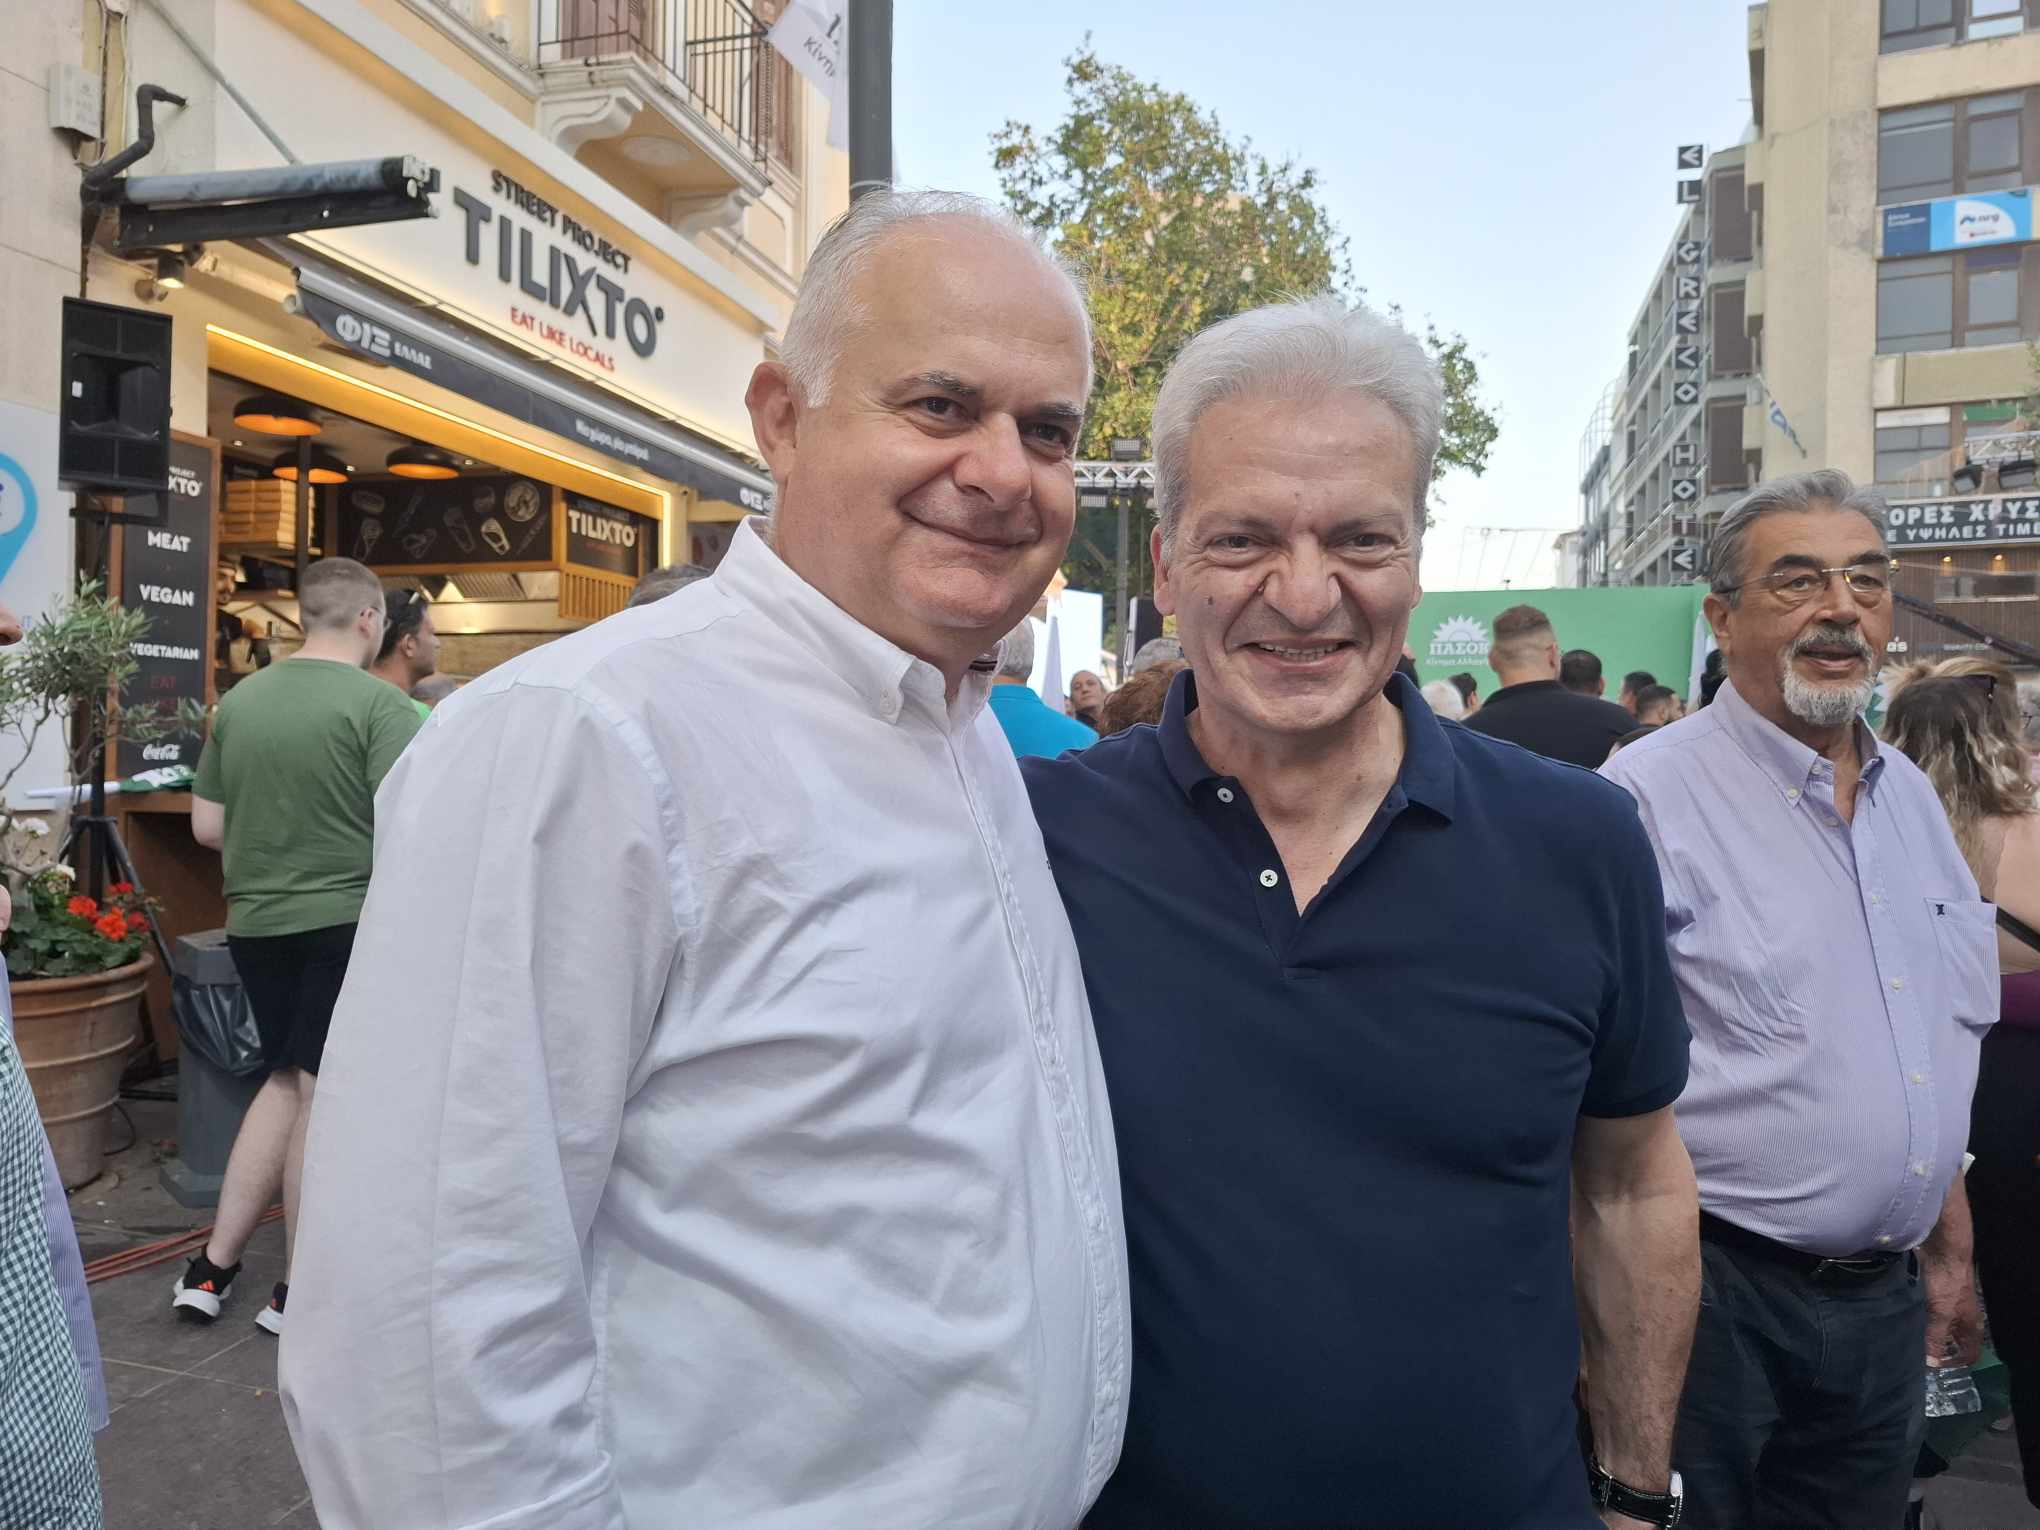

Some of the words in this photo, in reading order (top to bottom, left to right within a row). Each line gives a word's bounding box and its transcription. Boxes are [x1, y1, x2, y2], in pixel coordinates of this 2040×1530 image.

[491, 169, 559, 227] STREET
[562, 213, 631, 274] PROJECT
[453, 186, 657, 358] TILIXTO
[511, 306, 536, 333] EAT
[539, 320, 566, 350] LIKE
[569, 337, 615, 372] LOCALS
[168, 473, 201, 497] XTO
[1672, 444, 1698, 571] HOTE
[1888, 504, 1956, 526] ΟΡΕΣ
[568, 508, 636, 548] TILIXTO
[1886, 529, 1897, 542] Ε
[1906, 525, 1987, 541] ΥΨΗΛΕΣ
[147, 530, 191, 552] MEAT
[139, 584, 195, 607] VEGAN
[129, 642, 199, 660] VEGETARIAN
[1429, 642, 1489, 656] ΠΑΣΟΚ
